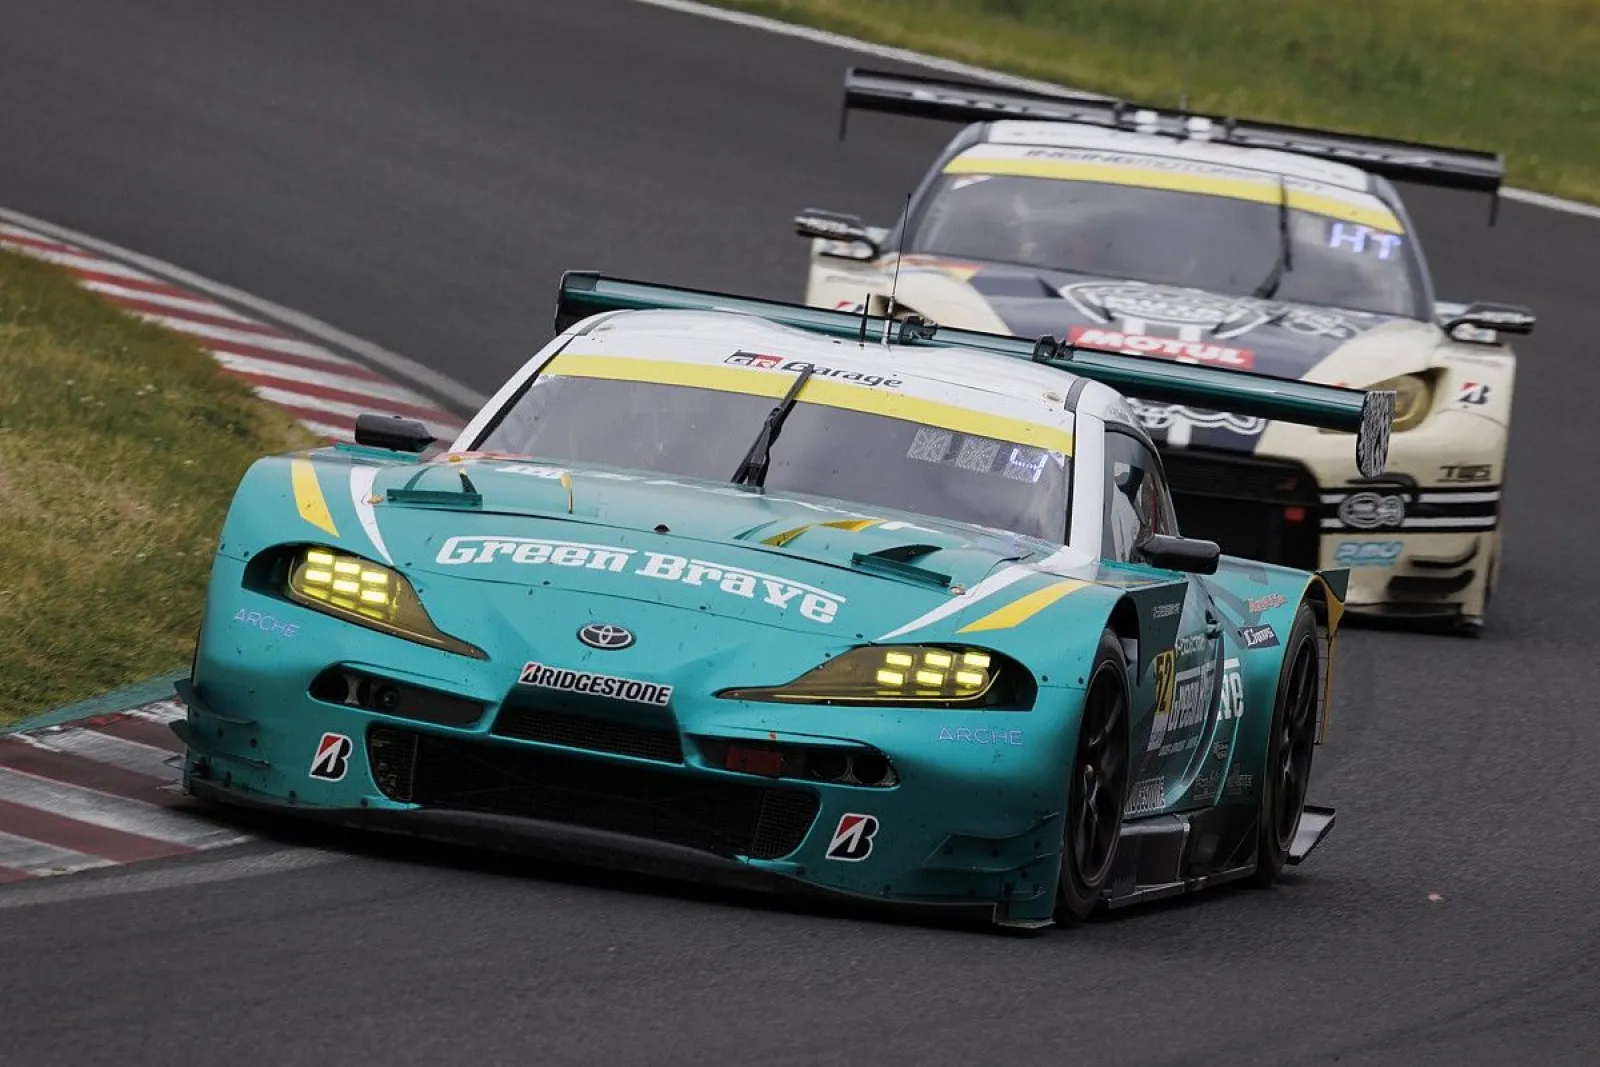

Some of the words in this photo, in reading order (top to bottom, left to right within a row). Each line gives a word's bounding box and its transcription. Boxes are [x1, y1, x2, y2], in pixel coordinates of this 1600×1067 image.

[1330, 222, 1402, 260] HT
[1079, 328, 1246, 366] MOTUL
[781, 361, 904, 387] Garage
[435, 535, 638, 573] Green
[635, 551, 847, 625] Brave
[233, 608, 301, 638] ARCHE
[521, 663, 672, 705] BRIDGESTONE
[1155, 653, 1174, 713] 52
[937, 725, 1024, 746] ARCHE
